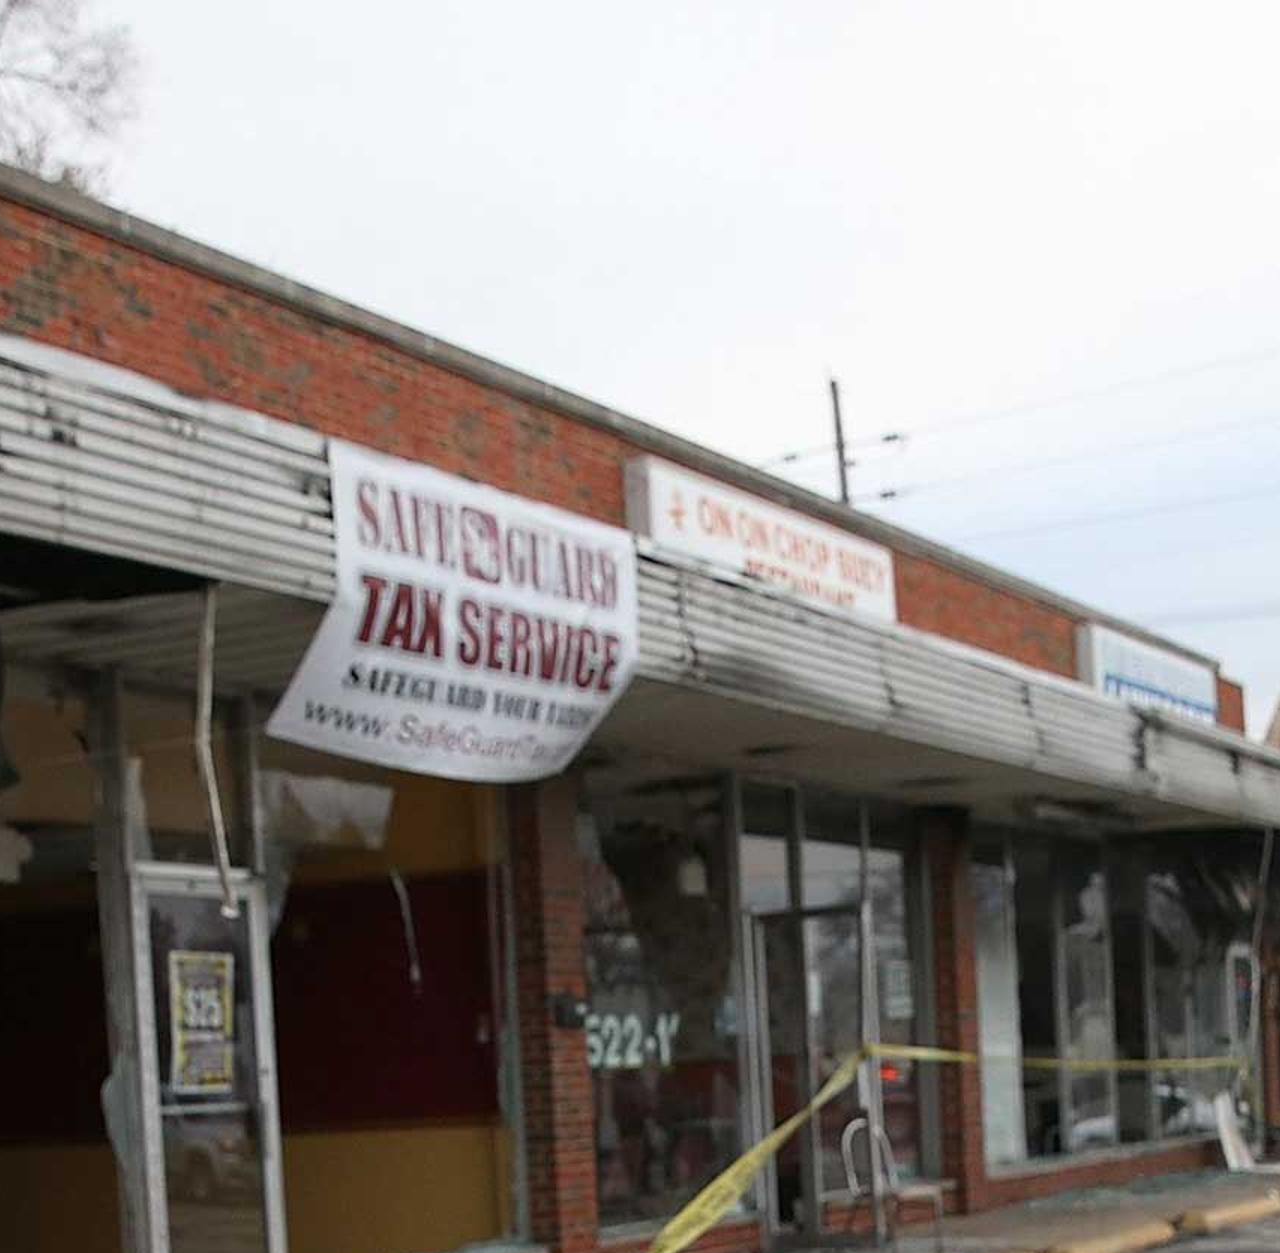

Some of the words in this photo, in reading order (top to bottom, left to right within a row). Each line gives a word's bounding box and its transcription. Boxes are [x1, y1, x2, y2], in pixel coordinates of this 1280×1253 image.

[506, 526, 618, 611] GUARD
[356, 573, 445, 658] TAX
[458, 599, 621, 691] SERVICE
